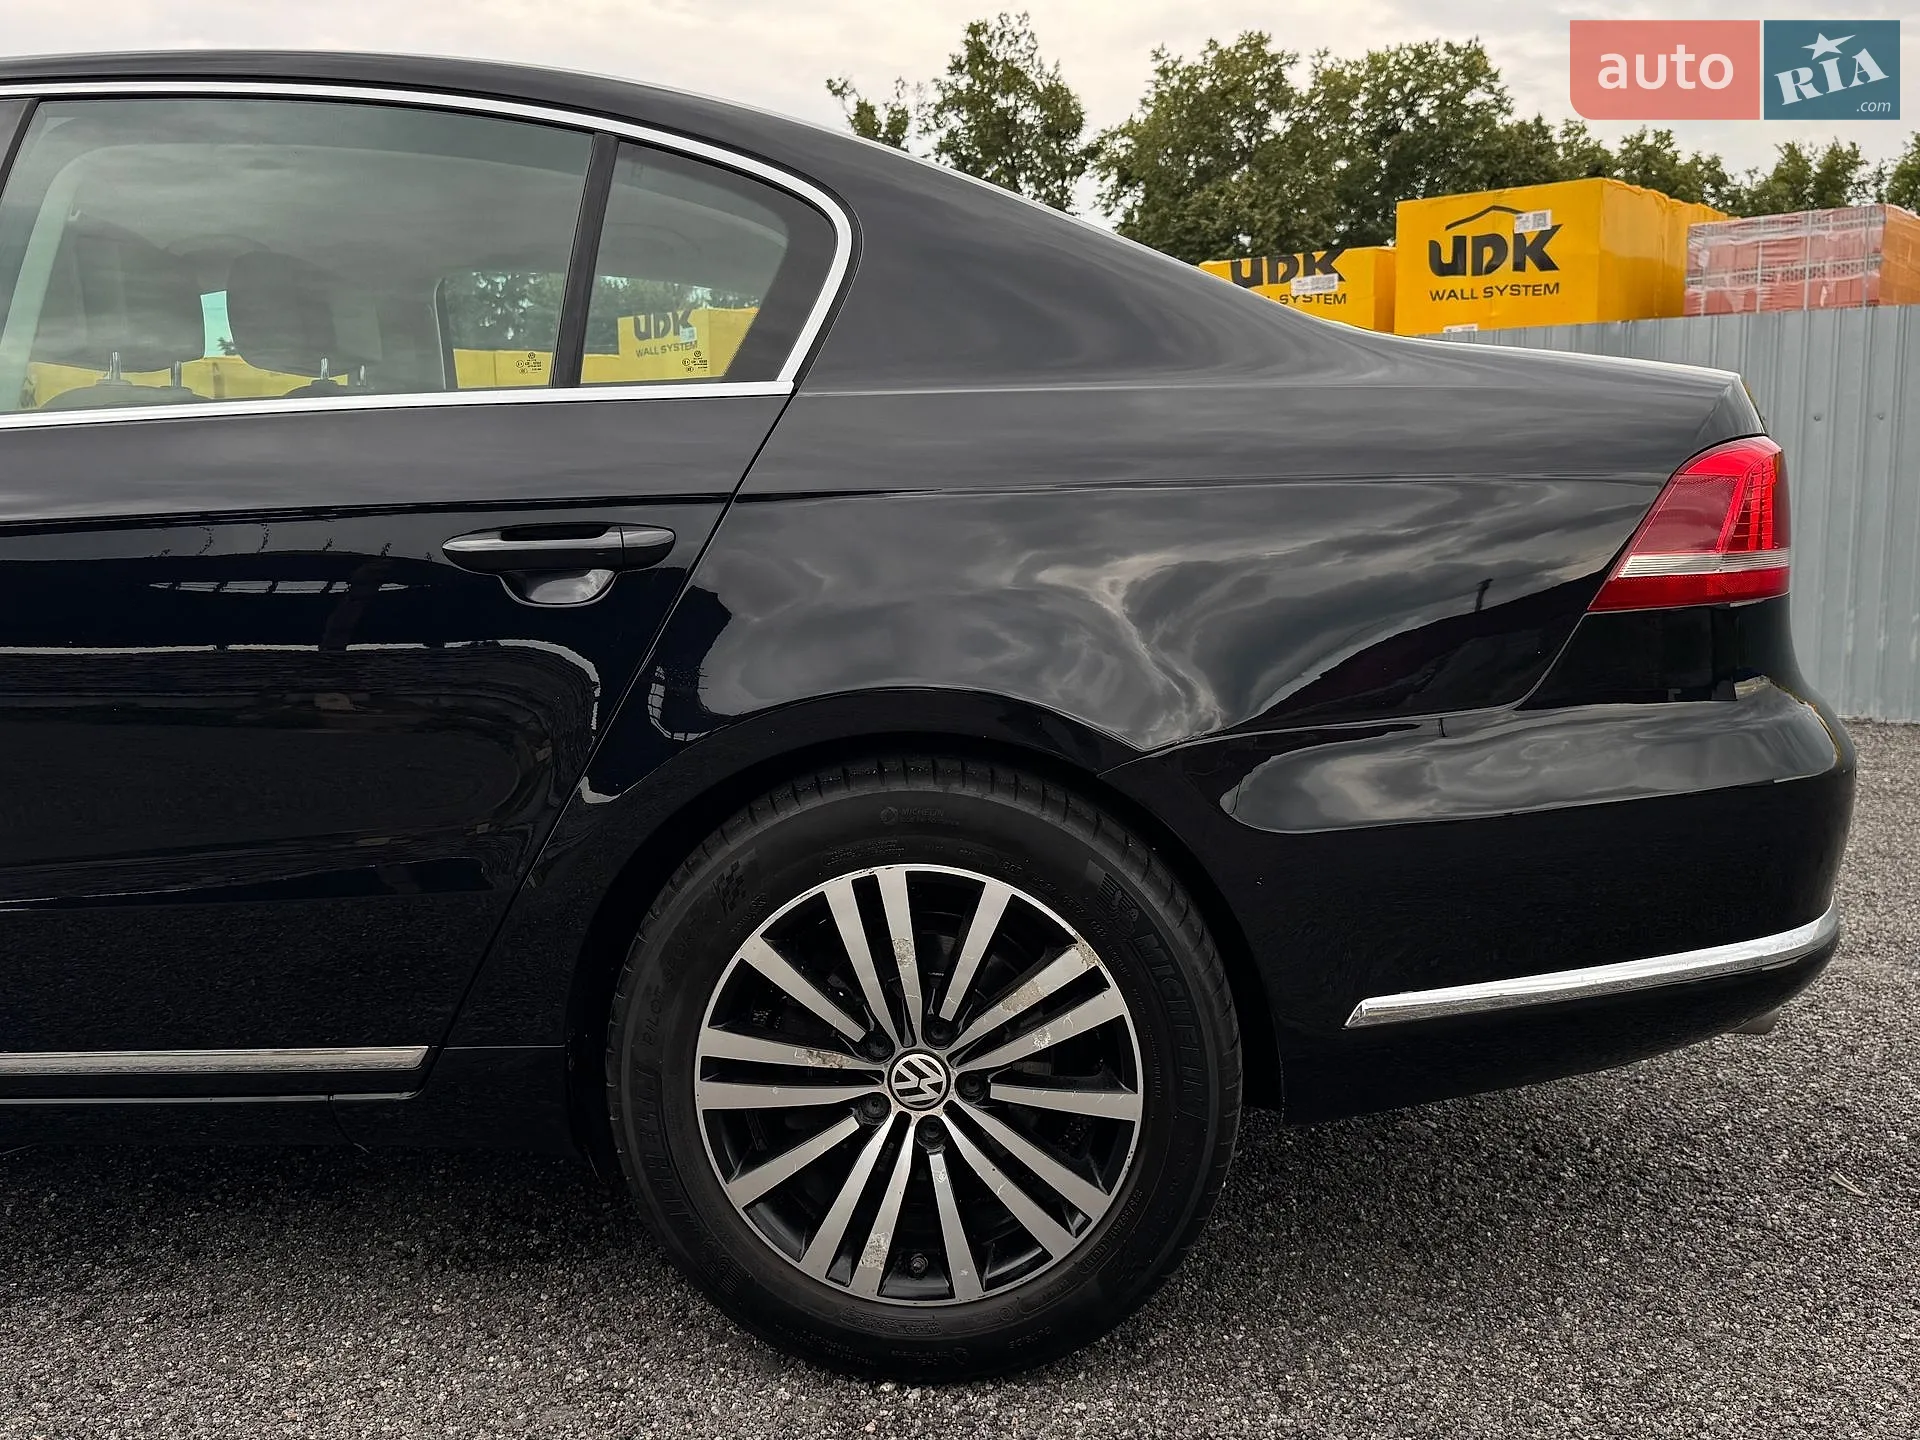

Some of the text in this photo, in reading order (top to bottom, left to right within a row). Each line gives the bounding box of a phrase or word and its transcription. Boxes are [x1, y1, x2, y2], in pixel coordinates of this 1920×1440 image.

[1429, 223, 1563, 277] UDK
[1231, 247, 1346, 289] UDK
[1279, 293, 1347, 305] SYSTEM
[1430, 282, 1560, 302] WALL SYSTEM
[633, 304, 694, 341] UDK
[636, 340, 698, 358] WALL SYSTEM
